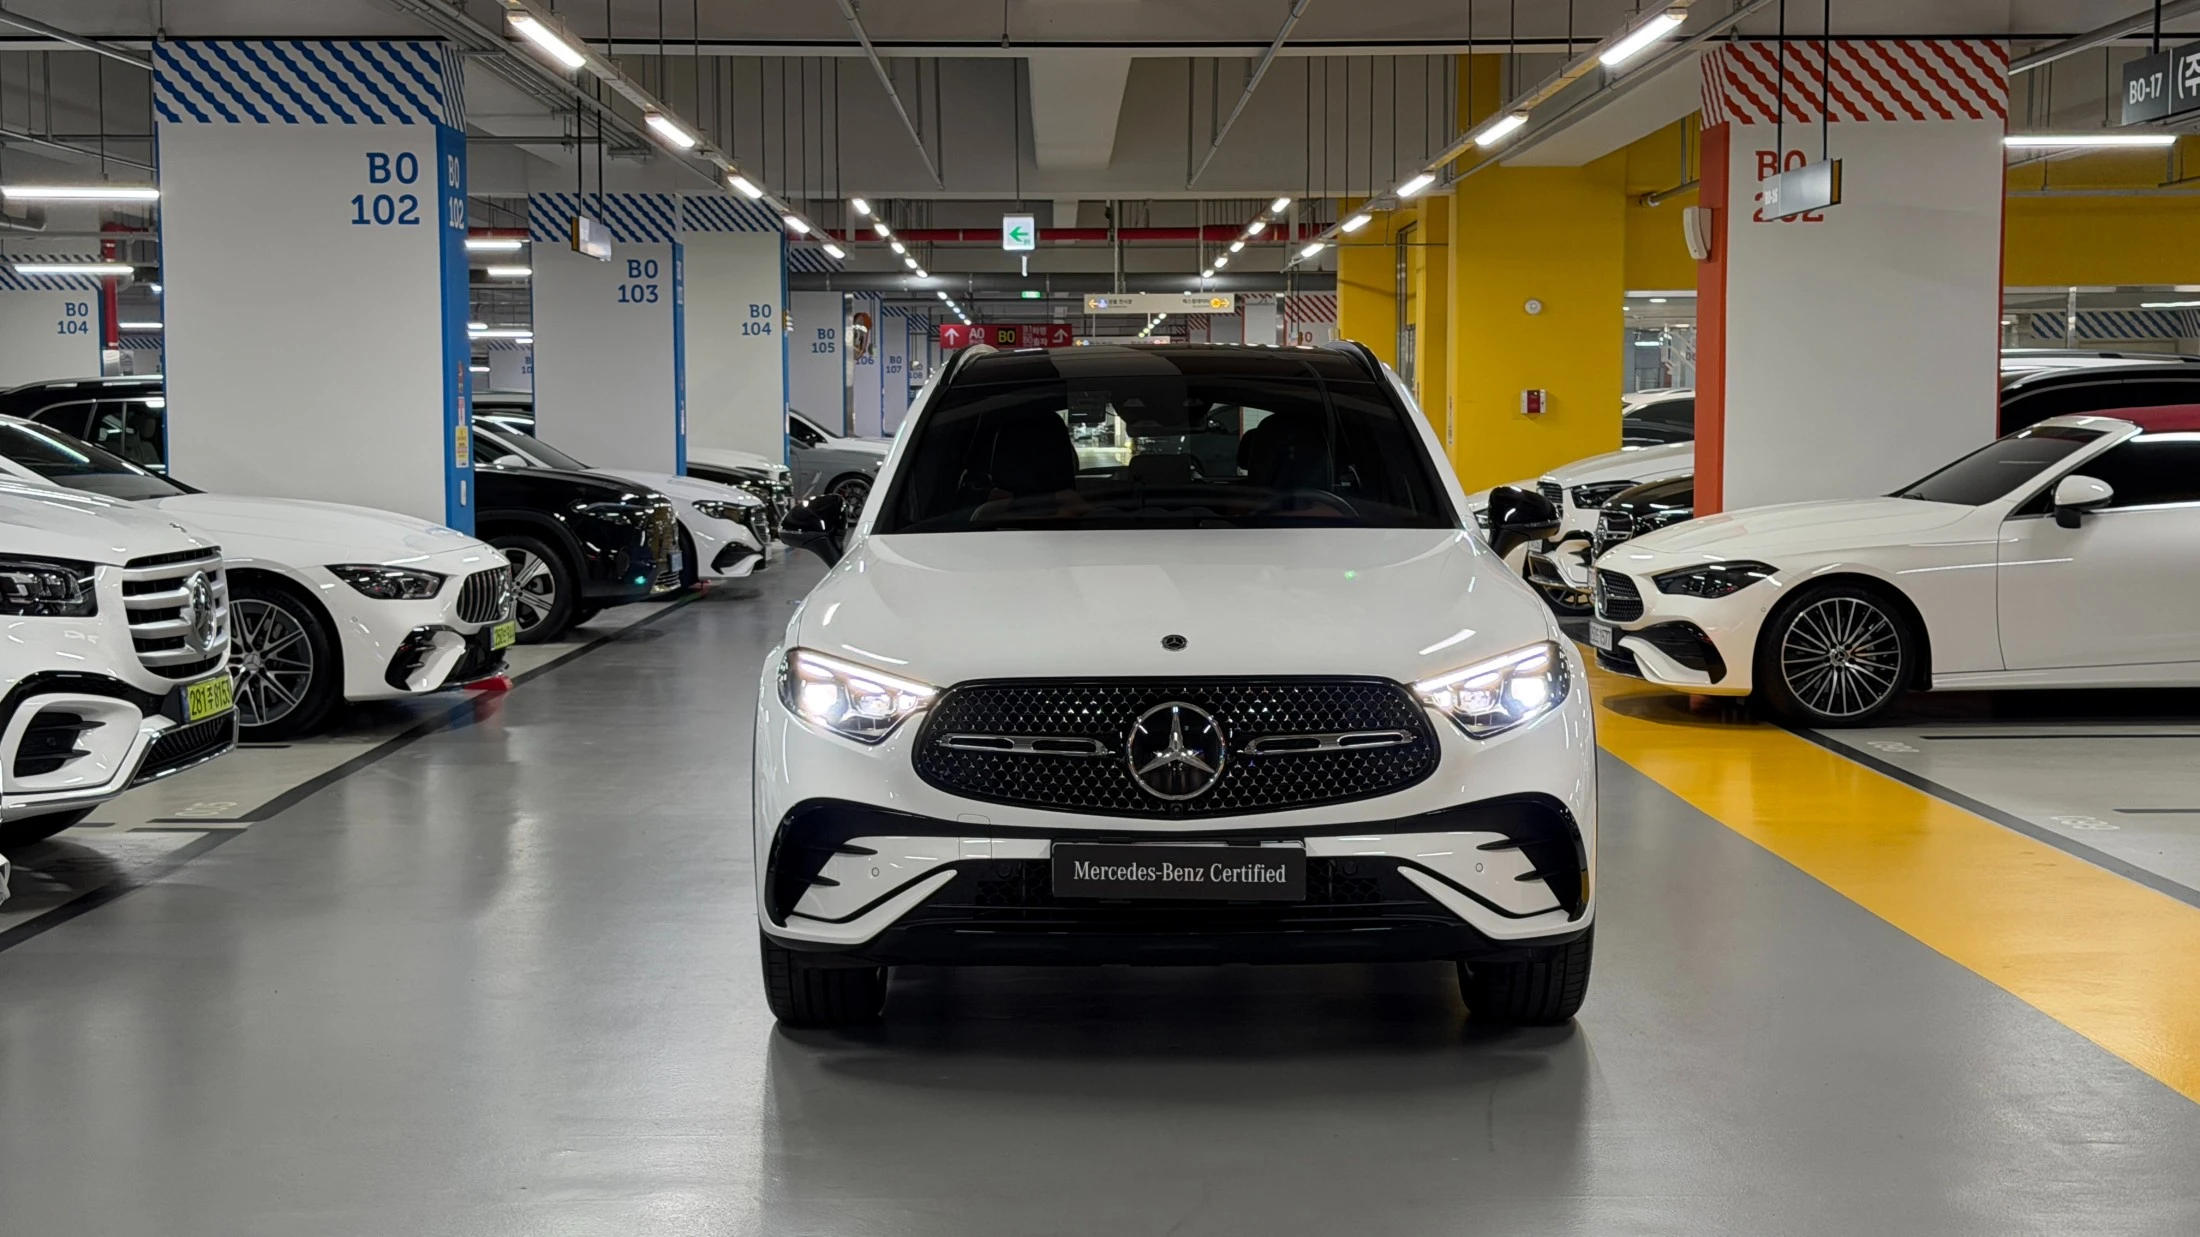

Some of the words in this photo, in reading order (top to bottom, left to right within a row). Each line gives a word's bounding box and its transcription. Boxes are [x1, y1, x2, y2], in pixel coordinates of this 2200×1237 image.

[2129, 72, 2163, 105] B0-17
[366, 152, 418, 184] B0
[448, 154, 460, 189] B0
[351, 194, 420, 225] 102
[449, 196, 464, 229] 102
[627, 259, 658, 278] B0
[618, 284, 659, 303] 103
[65, 302, 88, 317] B0
[749, 304, 772, 318] B0
[57, 320, 88, 334] 104
[742, 321, 772, 336] 104
[817, 328, 835, 340] B0
[969, 328, 985, 339] A0
[998, 330, 1016, 343] B0
[812, 342, 835, 354] 105
[889, 356, 902, 364] B0
[886, 365, 902, 374] 107
[1073, 861, 1204, 882] Mercedes-Benz
[1210, 863, 1286, 883] Certified
